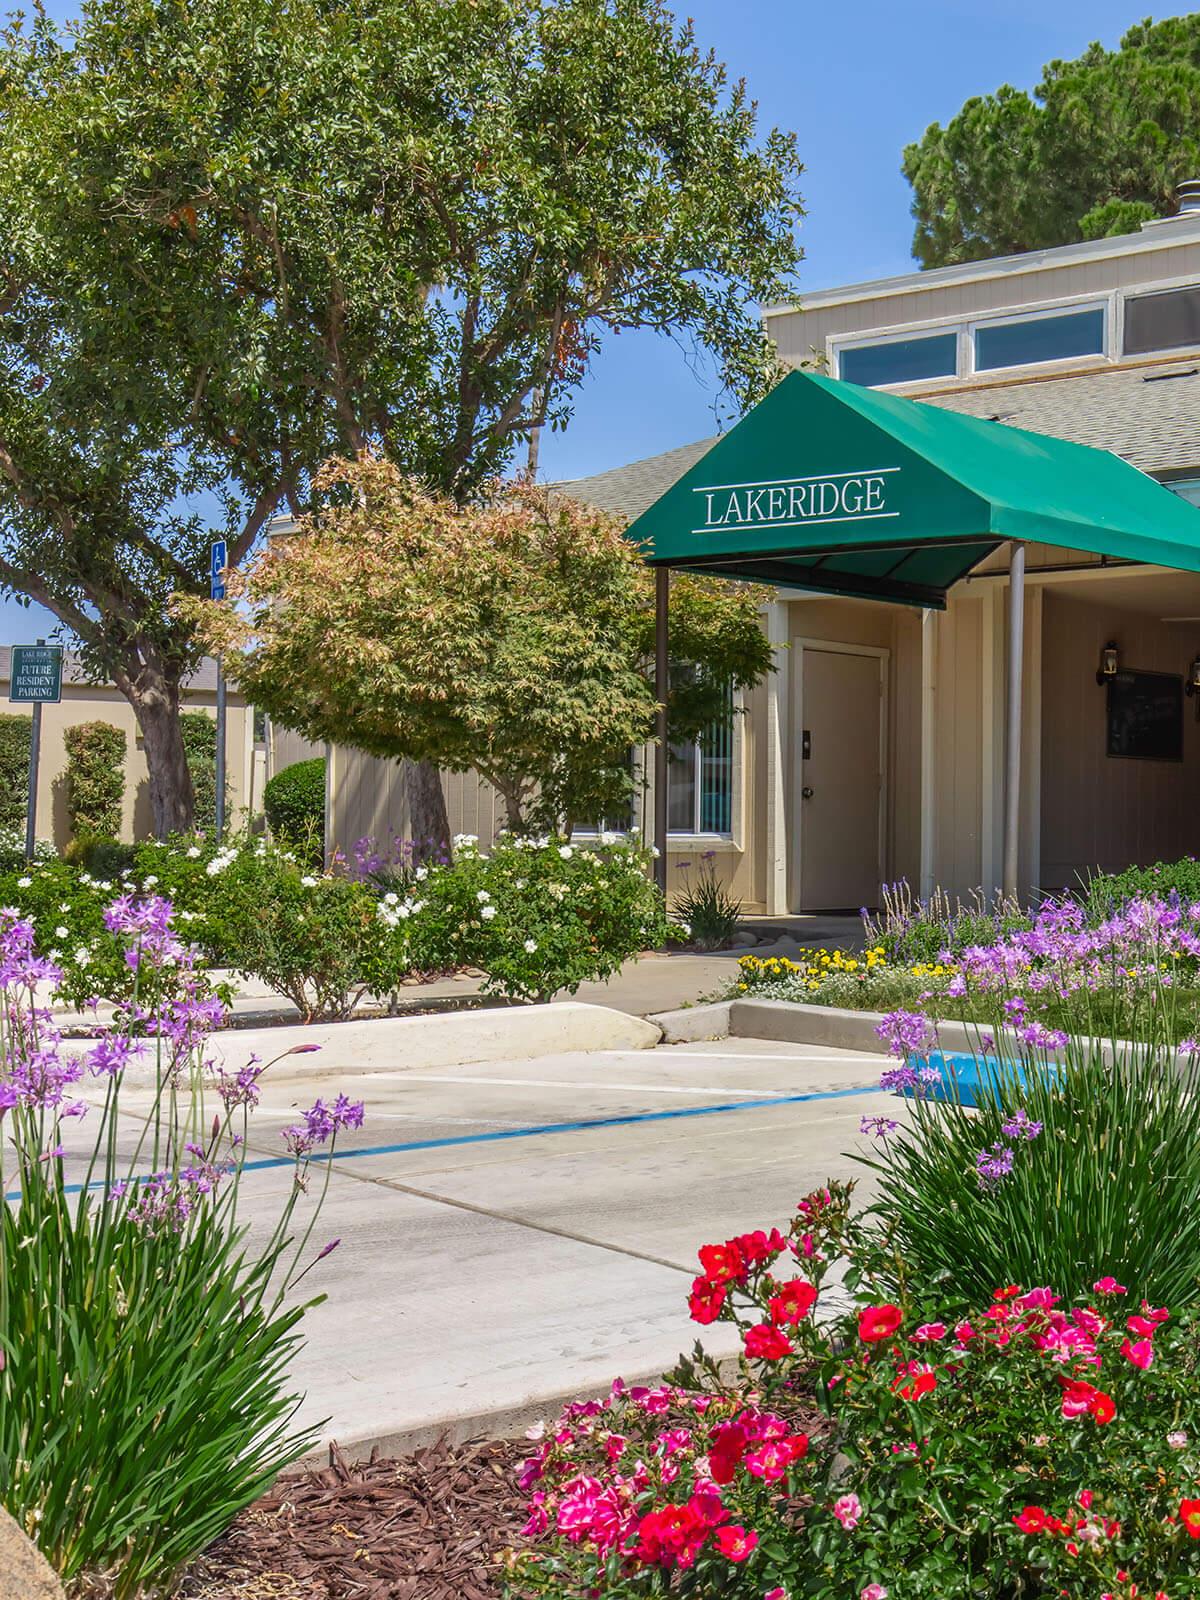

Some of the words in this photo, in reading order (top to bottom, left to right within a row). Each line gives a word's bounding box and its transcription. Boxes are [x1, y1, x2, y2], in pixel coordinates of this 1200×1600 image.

[704, 477, 886, 526] LAKERIDGE
[21, 664, 52, 675] FUTURE
[16, 676, 55, 686] RESIDENT
[18, 687, 52, 697] PARKING
